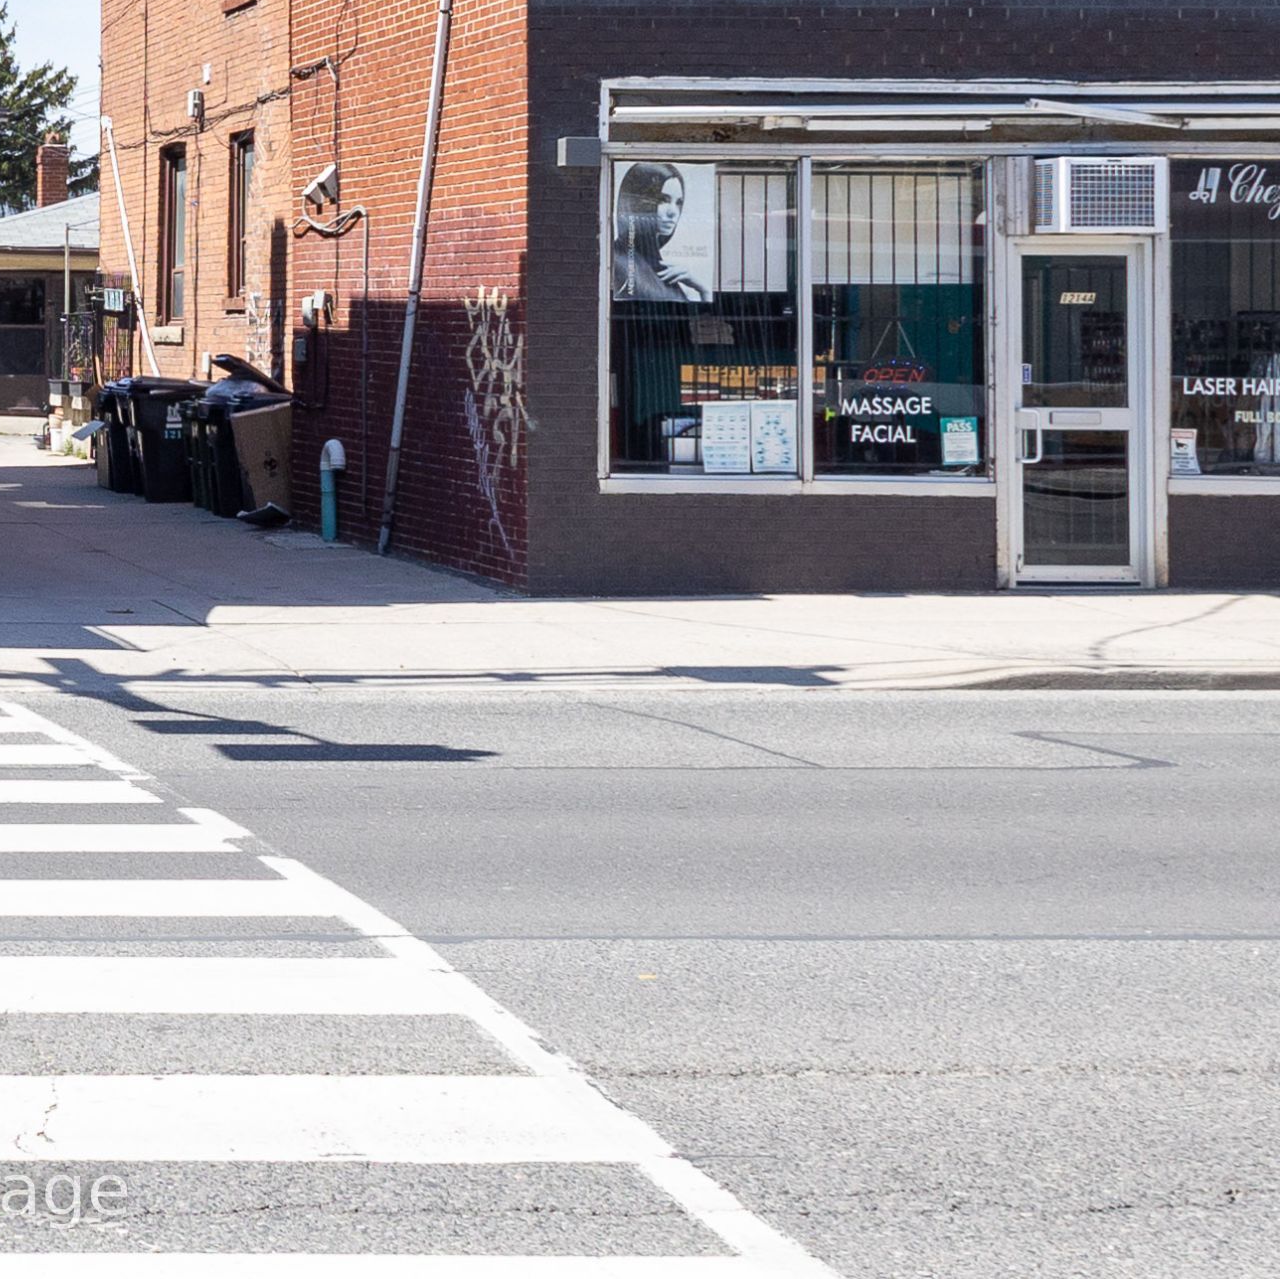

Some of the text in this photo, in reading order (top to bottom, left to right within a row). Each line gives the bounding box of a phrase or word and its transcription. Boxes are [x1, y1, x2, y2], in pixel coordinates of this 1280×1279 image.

[863, 368, 926, 384] OPEN
[1183, 377, 1237, 396] LASER
[841, 396, 932, 415] MASSAGE
[1235, 410, 1264, 423] FULL
[851, 424, 917, 443] FACIAL
[946, 421, 973, 433] PASS
